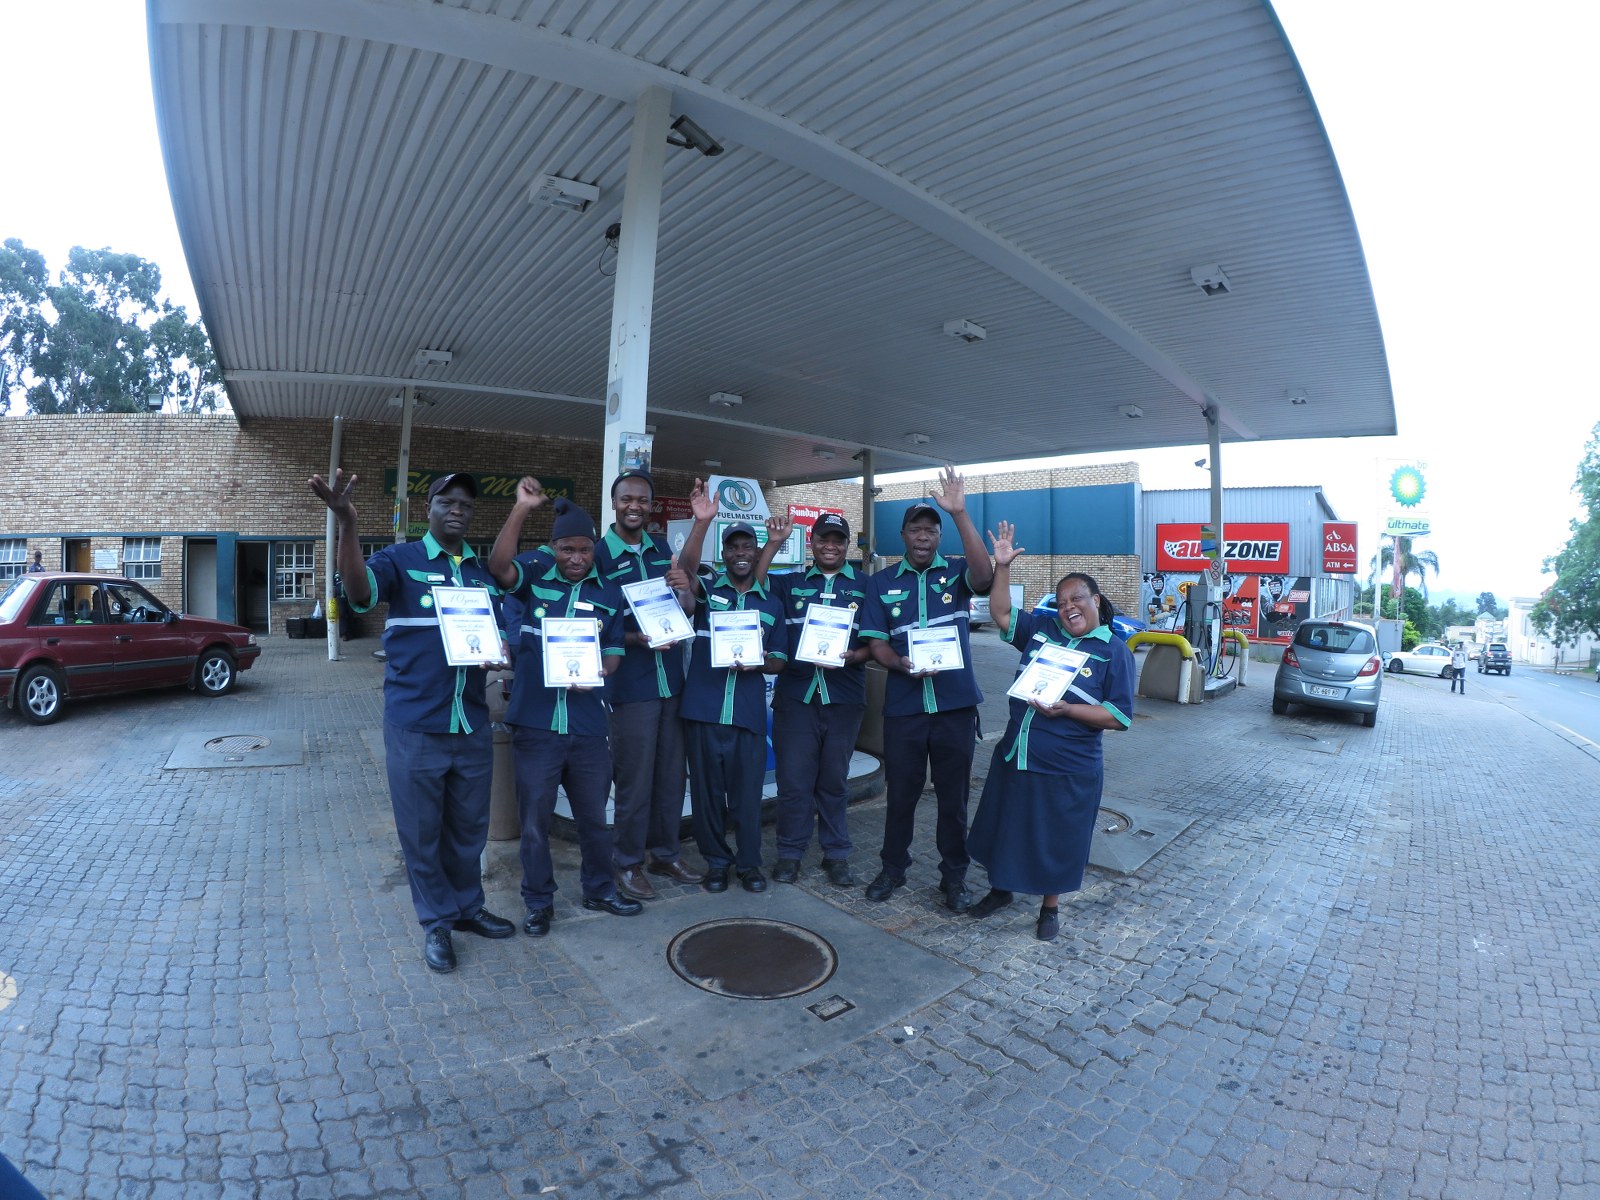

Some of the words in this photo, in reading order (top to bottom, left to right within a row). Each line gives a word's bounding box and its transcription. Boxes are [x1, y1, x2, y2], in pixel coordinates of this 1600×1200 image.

[717, 512, 764, 521] FUELMASTER
[790, 506, 819, 519] Sunday
[1387, 519, 1430, 531] ultimate
[1324, 542, 1356, 553] ABSA
[1326, 561, 1341, 569] ATM
